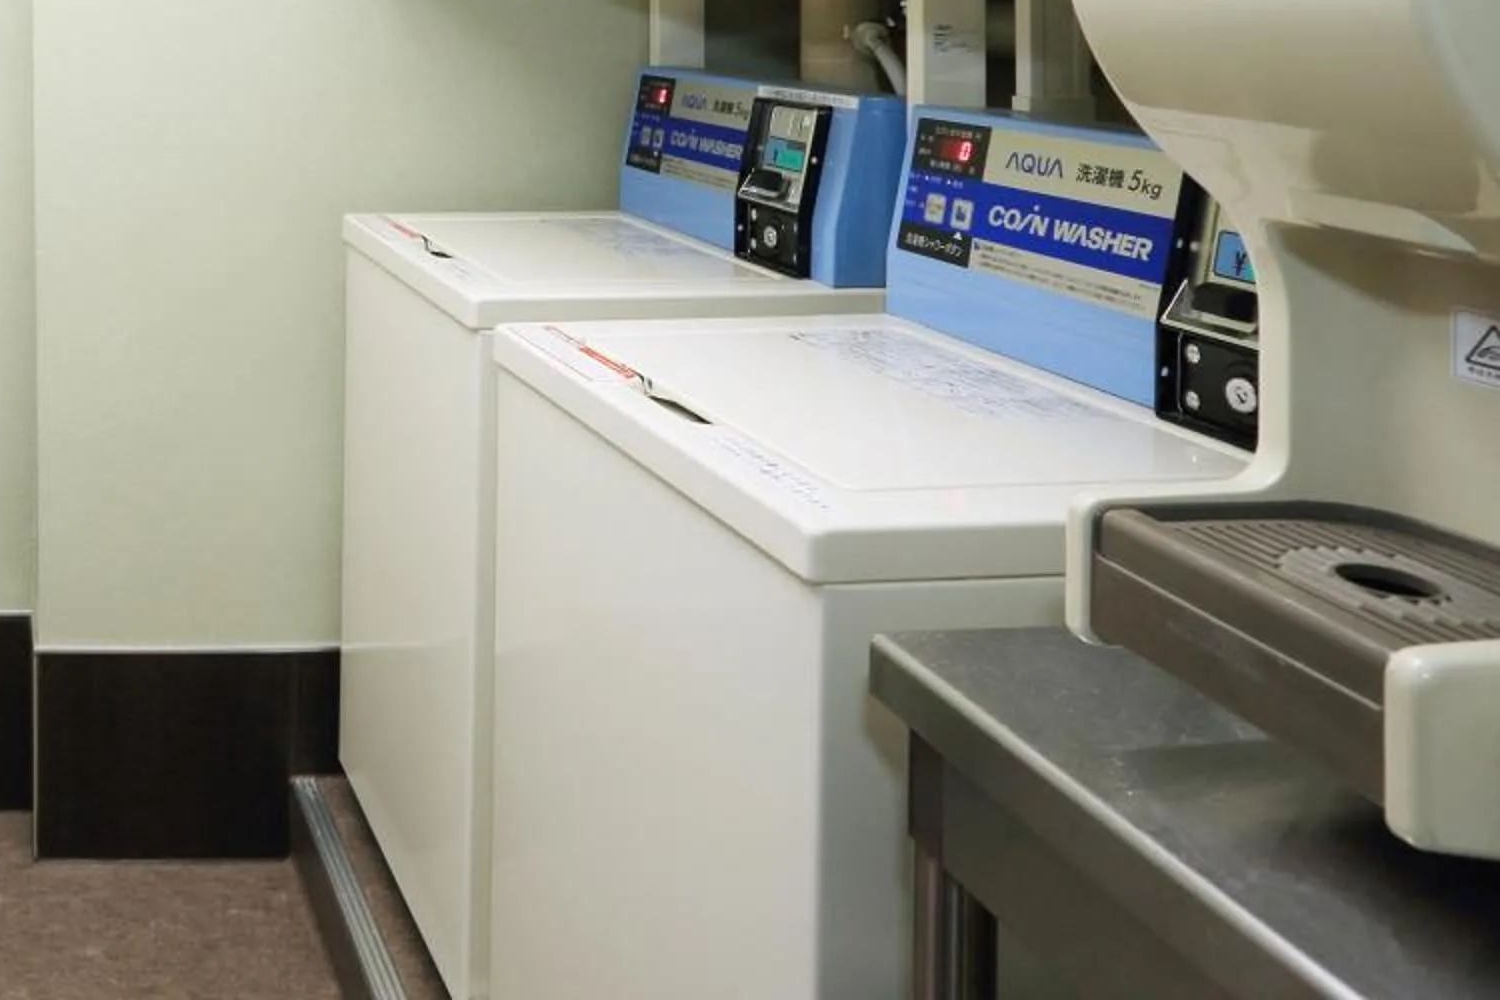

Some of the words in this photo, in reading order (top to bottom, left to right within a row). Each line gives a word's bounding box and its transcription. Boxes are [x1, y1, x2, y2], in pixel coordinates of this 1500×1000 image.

[958, 141, 972, 162] 0
[1005, 151, 1064, 180] AQUA
[1075, 162, 1126, 190] 洗濯機
[1127, 170, 1164, 201] 5kg
[987, 203, 1049, 238] COIN
[1053, 218, 1154, 264] WASHER
